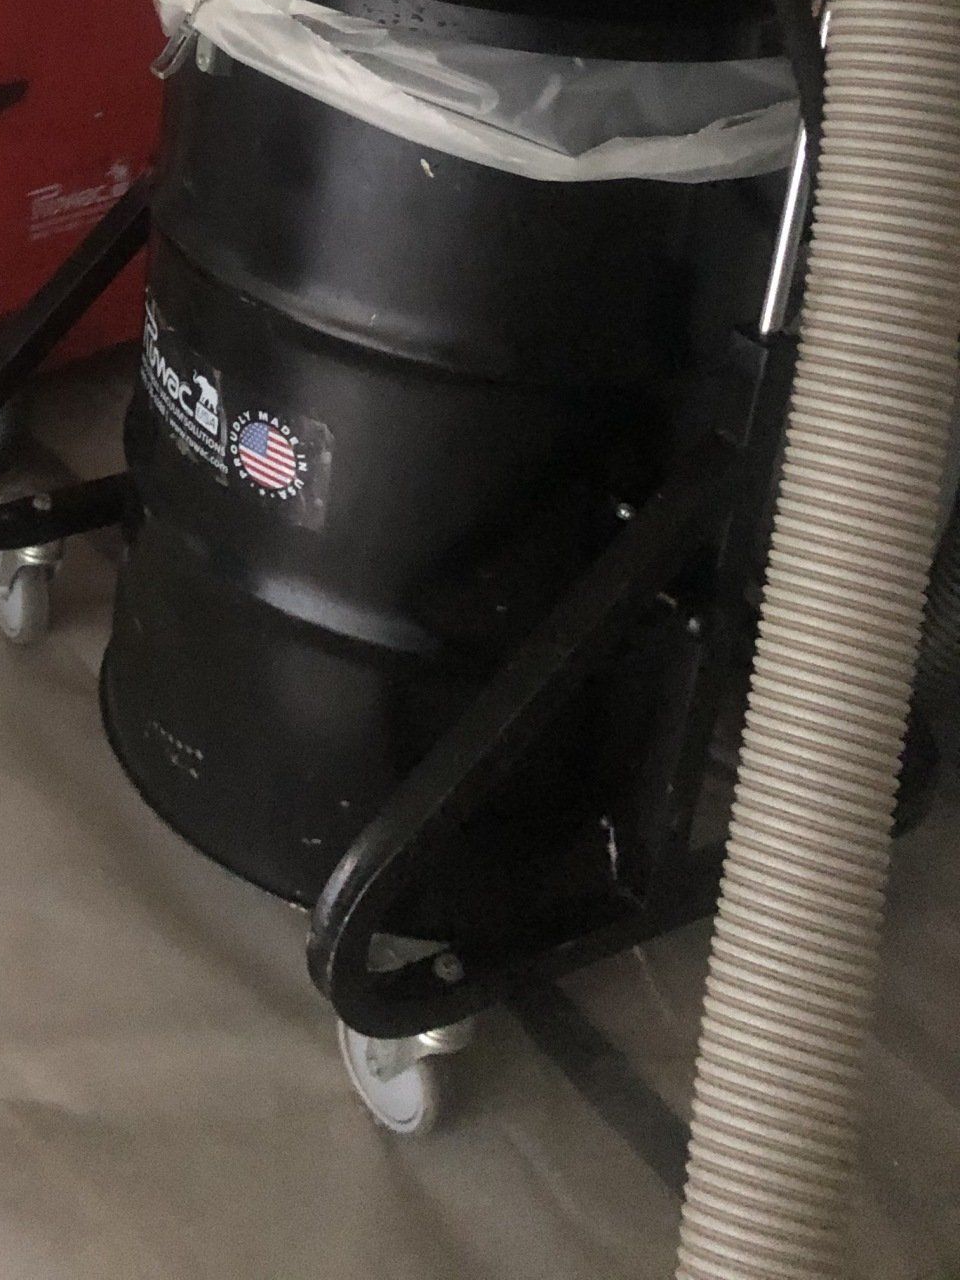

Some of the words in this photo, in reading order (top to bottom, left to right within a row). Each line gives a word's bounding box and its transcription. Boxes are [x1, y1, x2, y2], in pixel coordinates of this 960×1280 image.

[258, 410, 299, 445] MADE
[229, 410, 251, 479] PROUDLY
[296, 454, 308, 472] IN
[277, 478, 305, 500] USA
